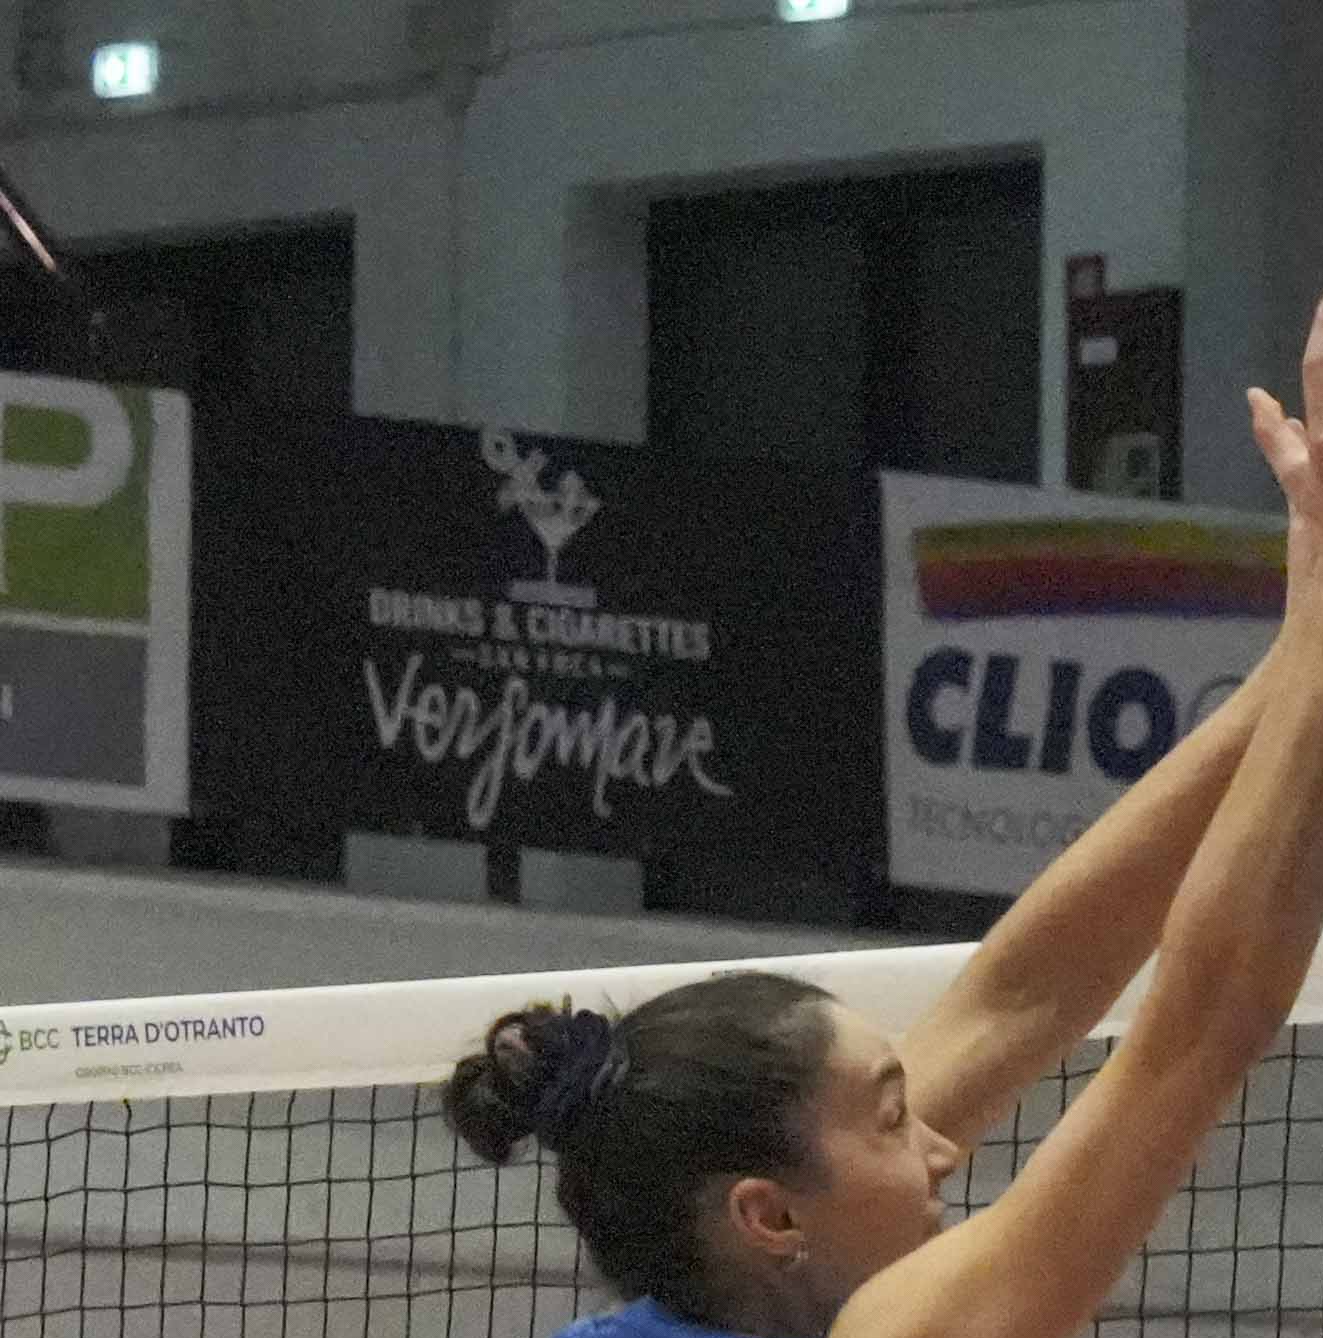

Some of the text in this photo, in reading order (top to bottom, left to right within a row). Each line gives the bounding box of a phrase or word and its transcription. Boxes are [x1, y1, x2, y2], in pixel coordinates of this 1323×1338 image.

[19, 1015, 266, 1051] BCC TERRA D'OTRANTO
